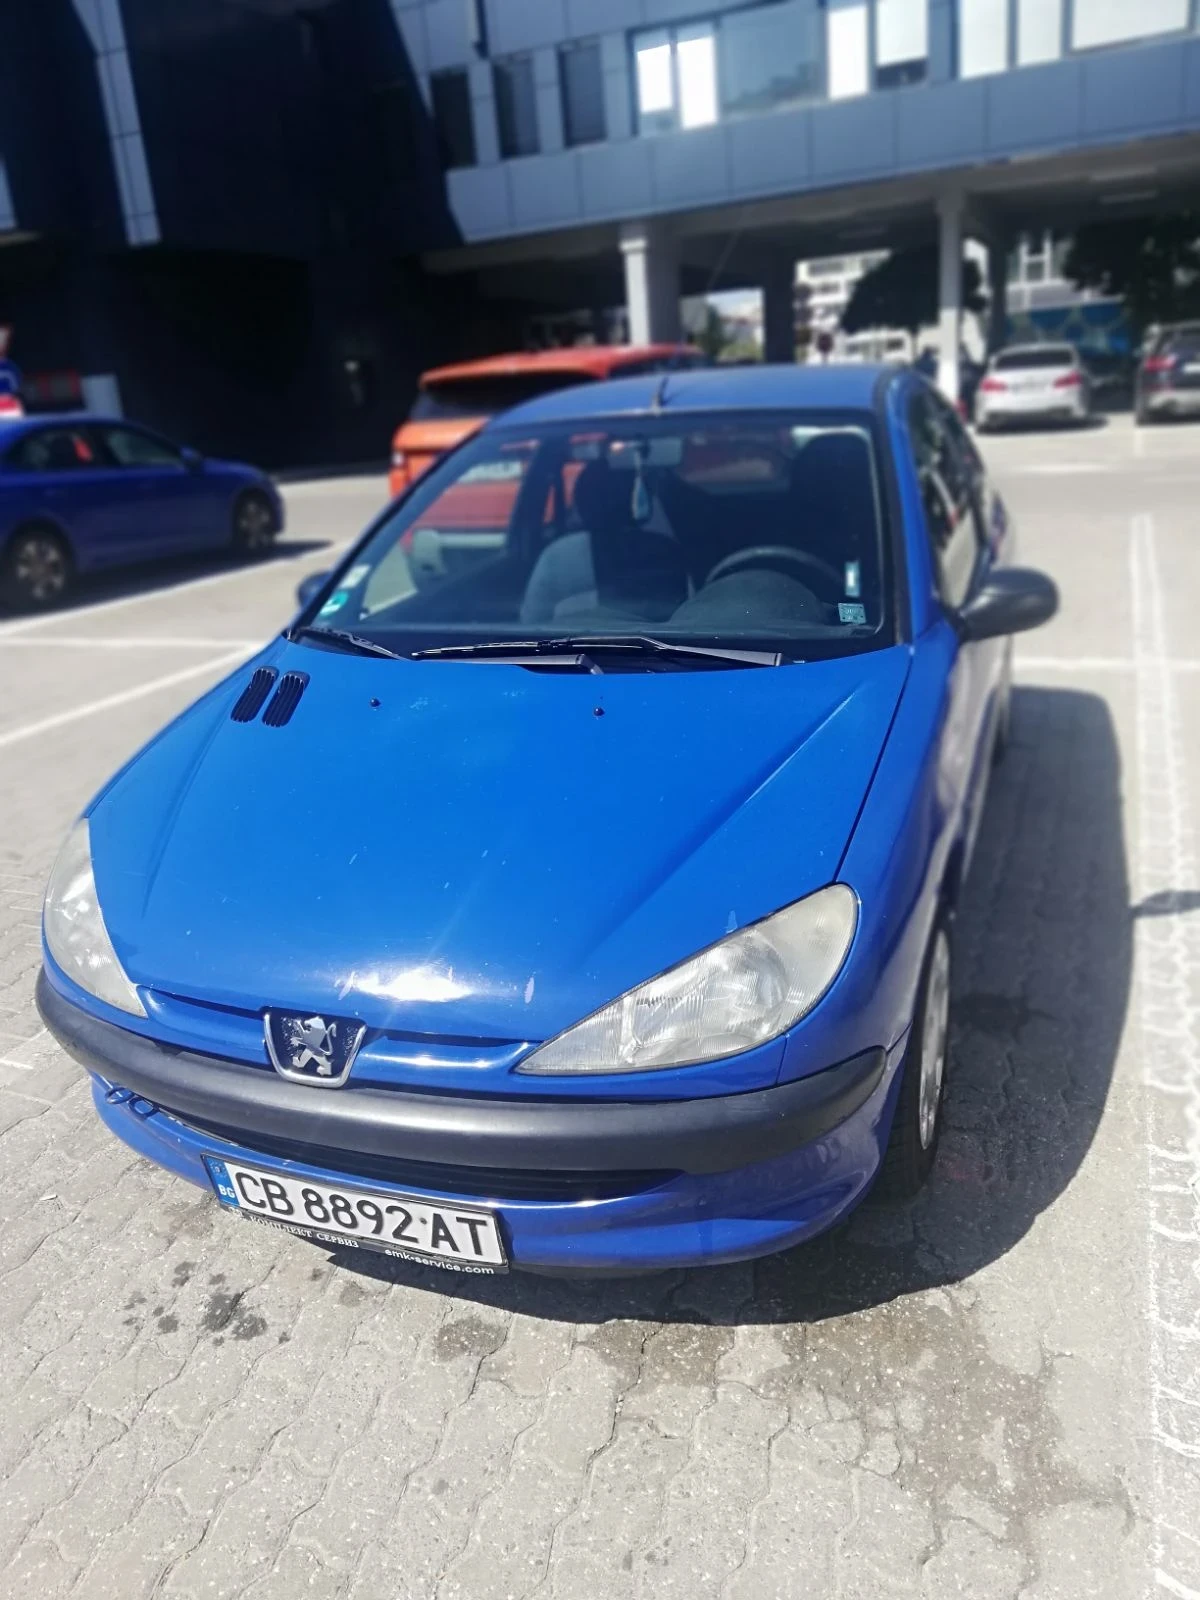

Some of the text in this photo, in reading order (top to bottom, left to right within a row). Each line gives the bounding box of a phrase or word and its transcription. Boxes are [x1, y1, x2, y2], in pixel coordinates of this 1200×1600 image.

[218, 1184, 236, 1199] BG
[235, 1172, 487, 1256] CB 8892 AT
[316, 1232, 360, 1248] СЕРВИЗ
